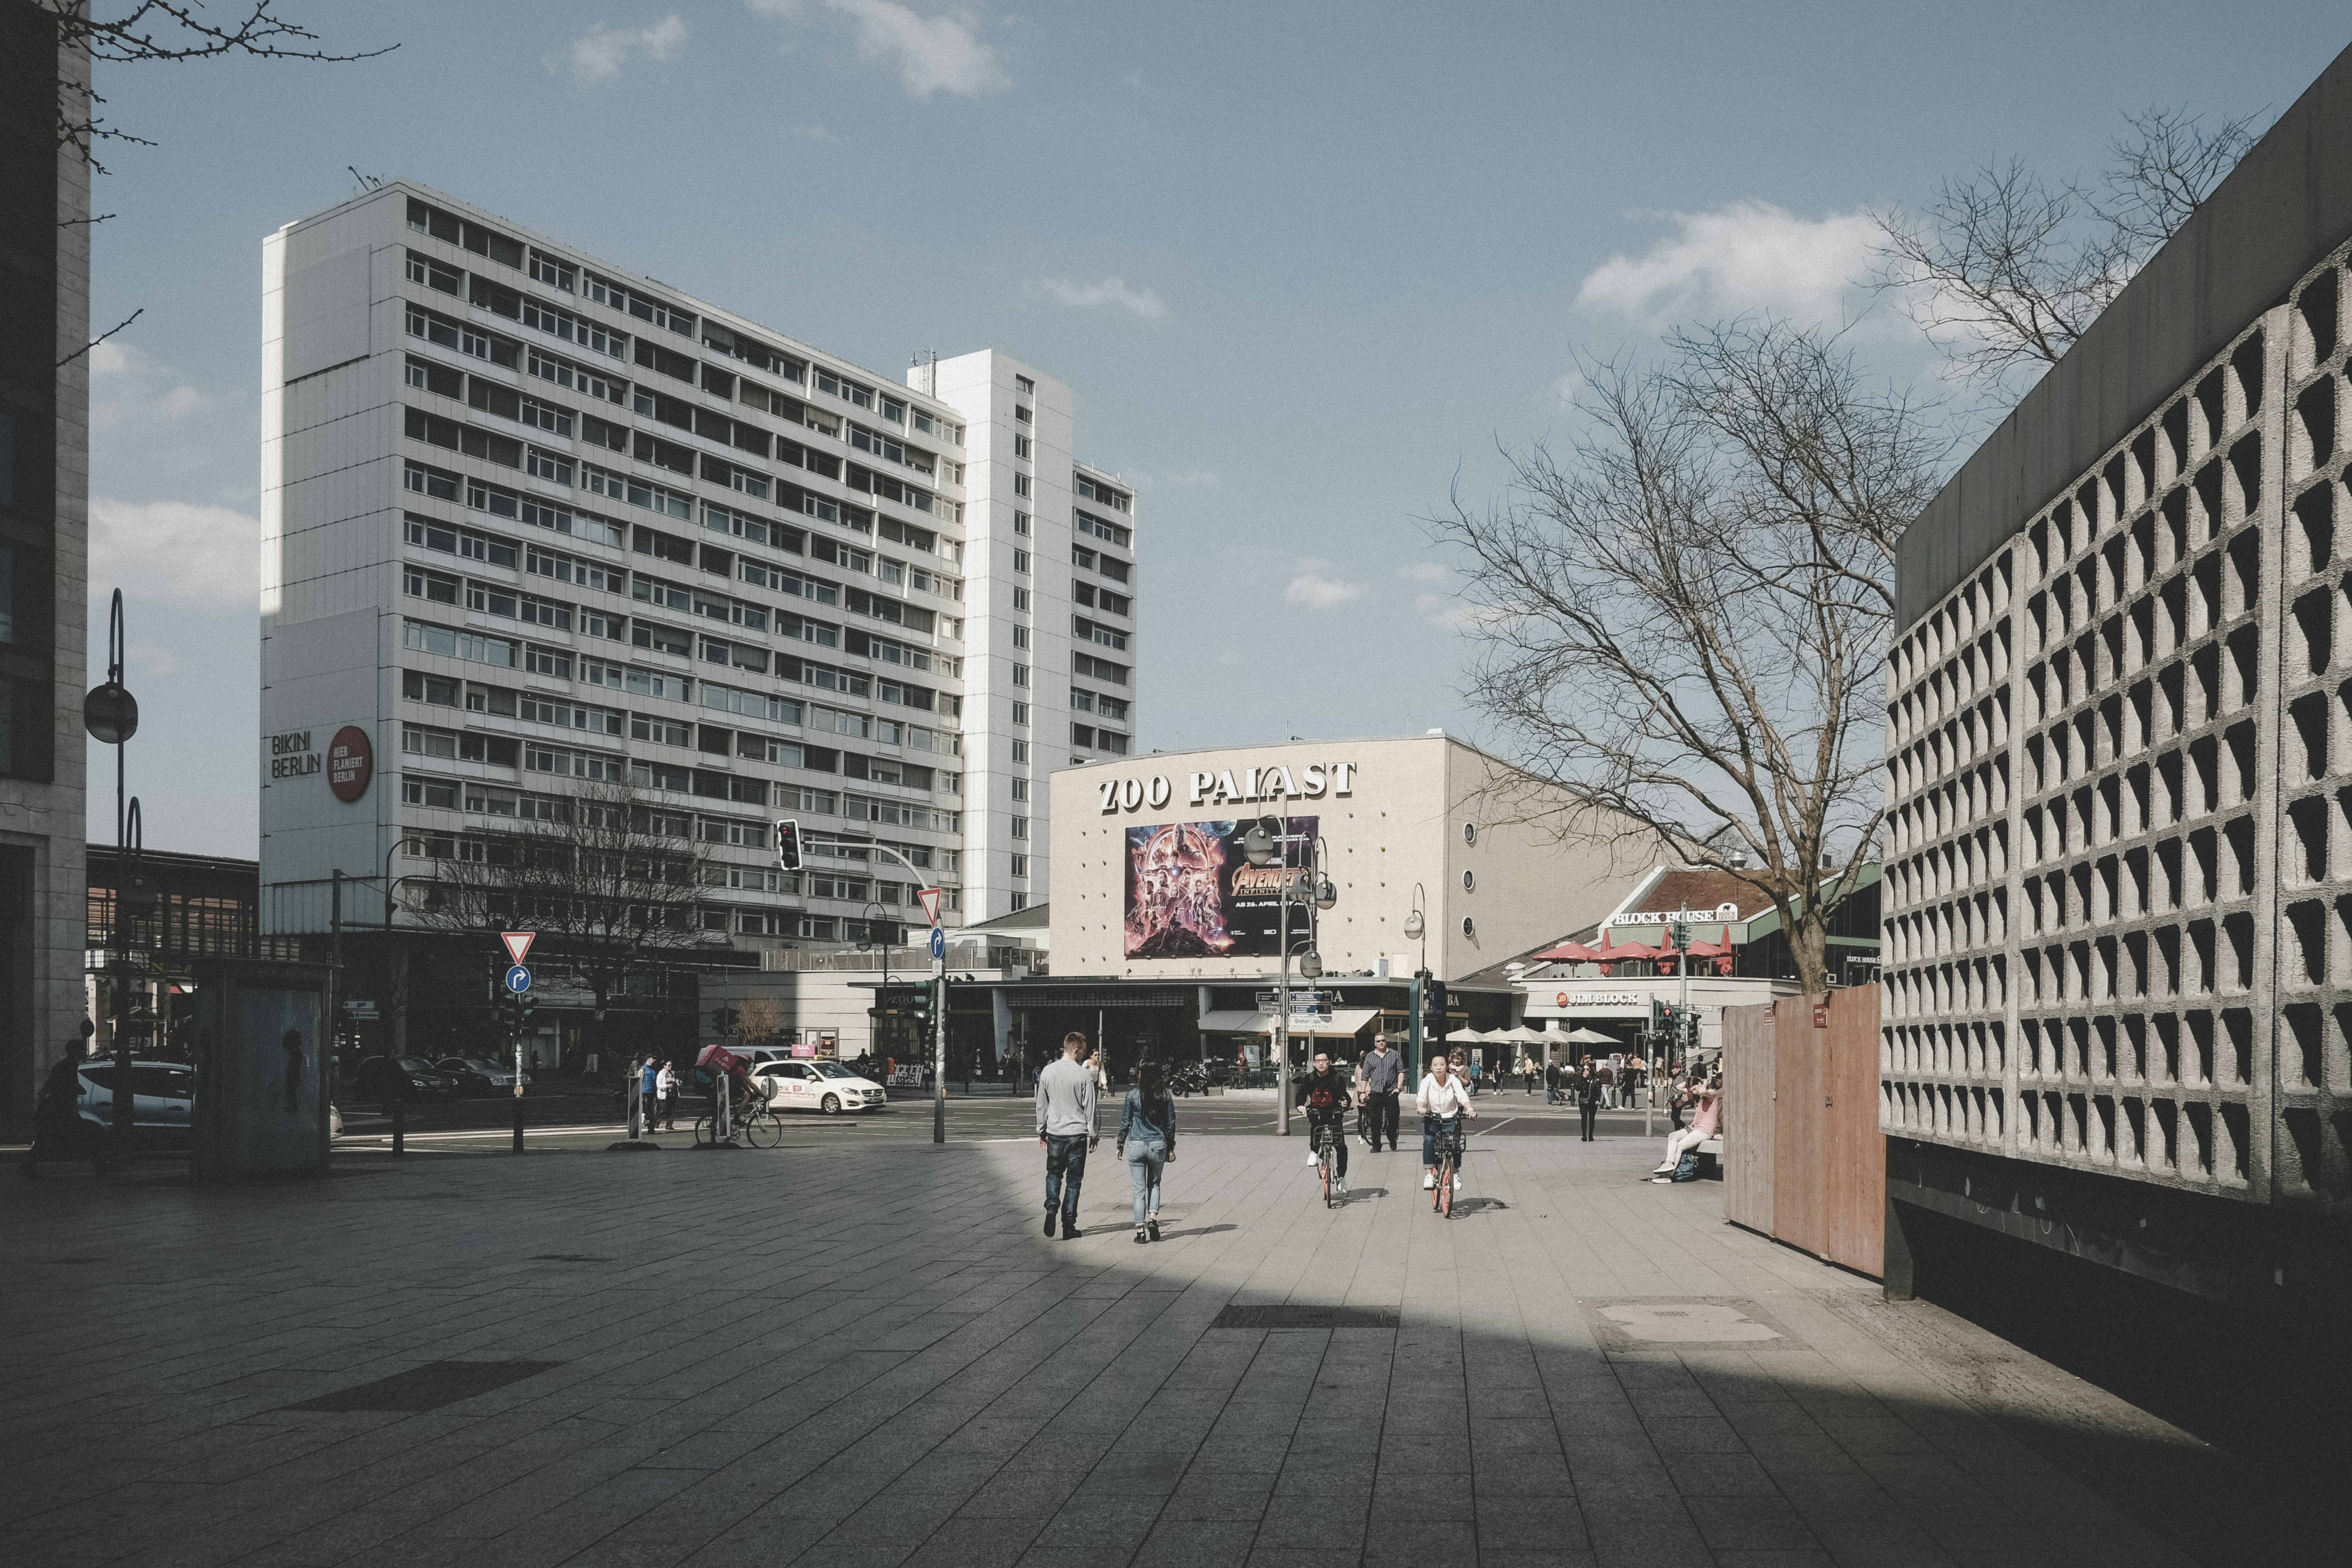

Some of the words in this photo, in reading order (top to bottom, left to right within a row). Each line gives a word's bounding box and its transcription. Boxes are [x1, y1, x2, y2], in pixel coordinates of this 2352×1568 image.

[272, 730, 310, 755] BIKINI
[334, 746, 348, 758] HIER
[272, 753, 321, 778] BERLIN
[333, 757, 363, 771] FLANIERT
[333, 770, 355, 783] BERLIN
[1098, 774, 1171, 811] ZOO
[1188, 760, 1357, 803] PALAST
[1615, 912, 1662, 925] BLOCK
[1558, 995, 1567, 1003] JB
[1570, 993, 1593, 1004] JIM
[1595, 993, 1638, 1004] BLOCK
